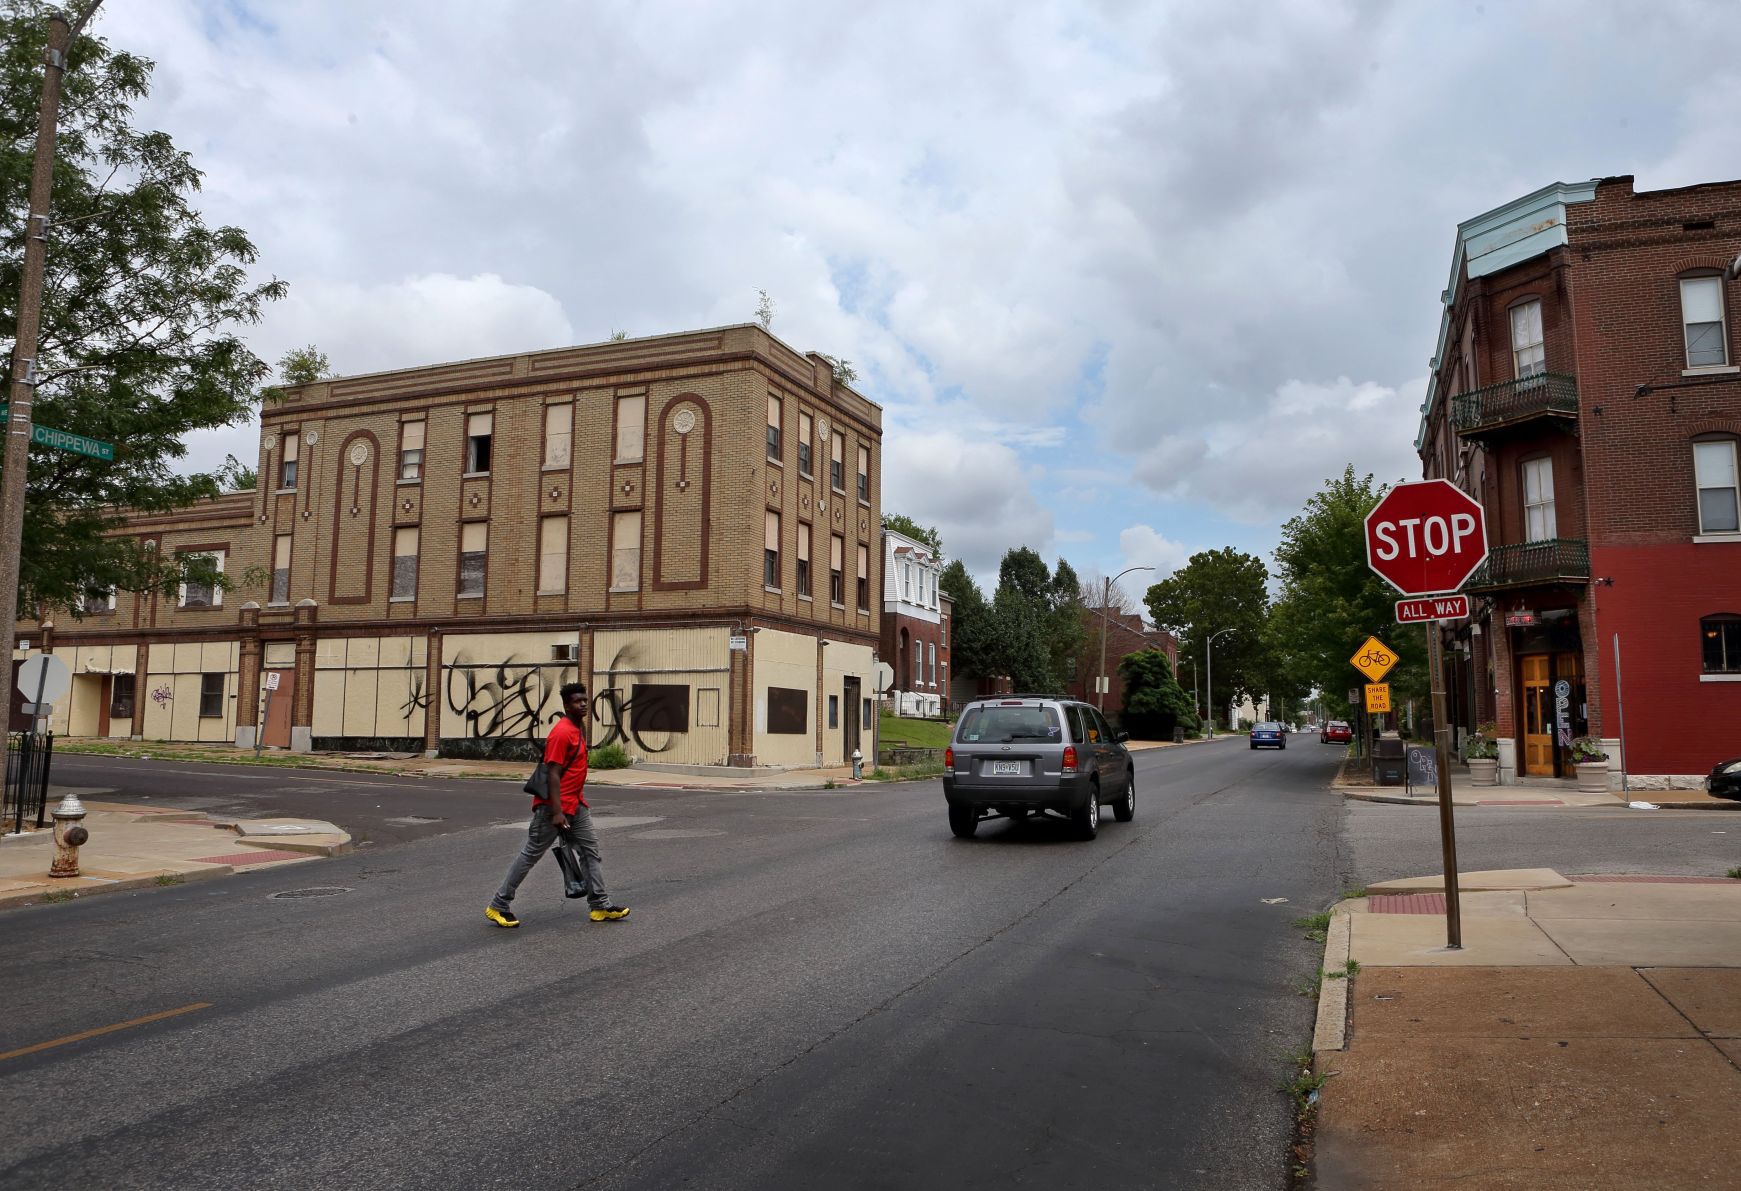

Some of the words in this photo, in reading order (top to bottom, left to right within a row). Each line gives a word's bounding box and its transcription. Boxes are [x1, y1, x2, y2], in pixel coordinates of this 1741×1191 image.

[35, 428, 100, 456] CHIPPEWA
[1375, 513, 1476, 560] STOP
[1403, 604, 1427, 618] ALL
[1435, 600, 1461, 615] WAY
[1554, 680, 1573, 747] OPEN
